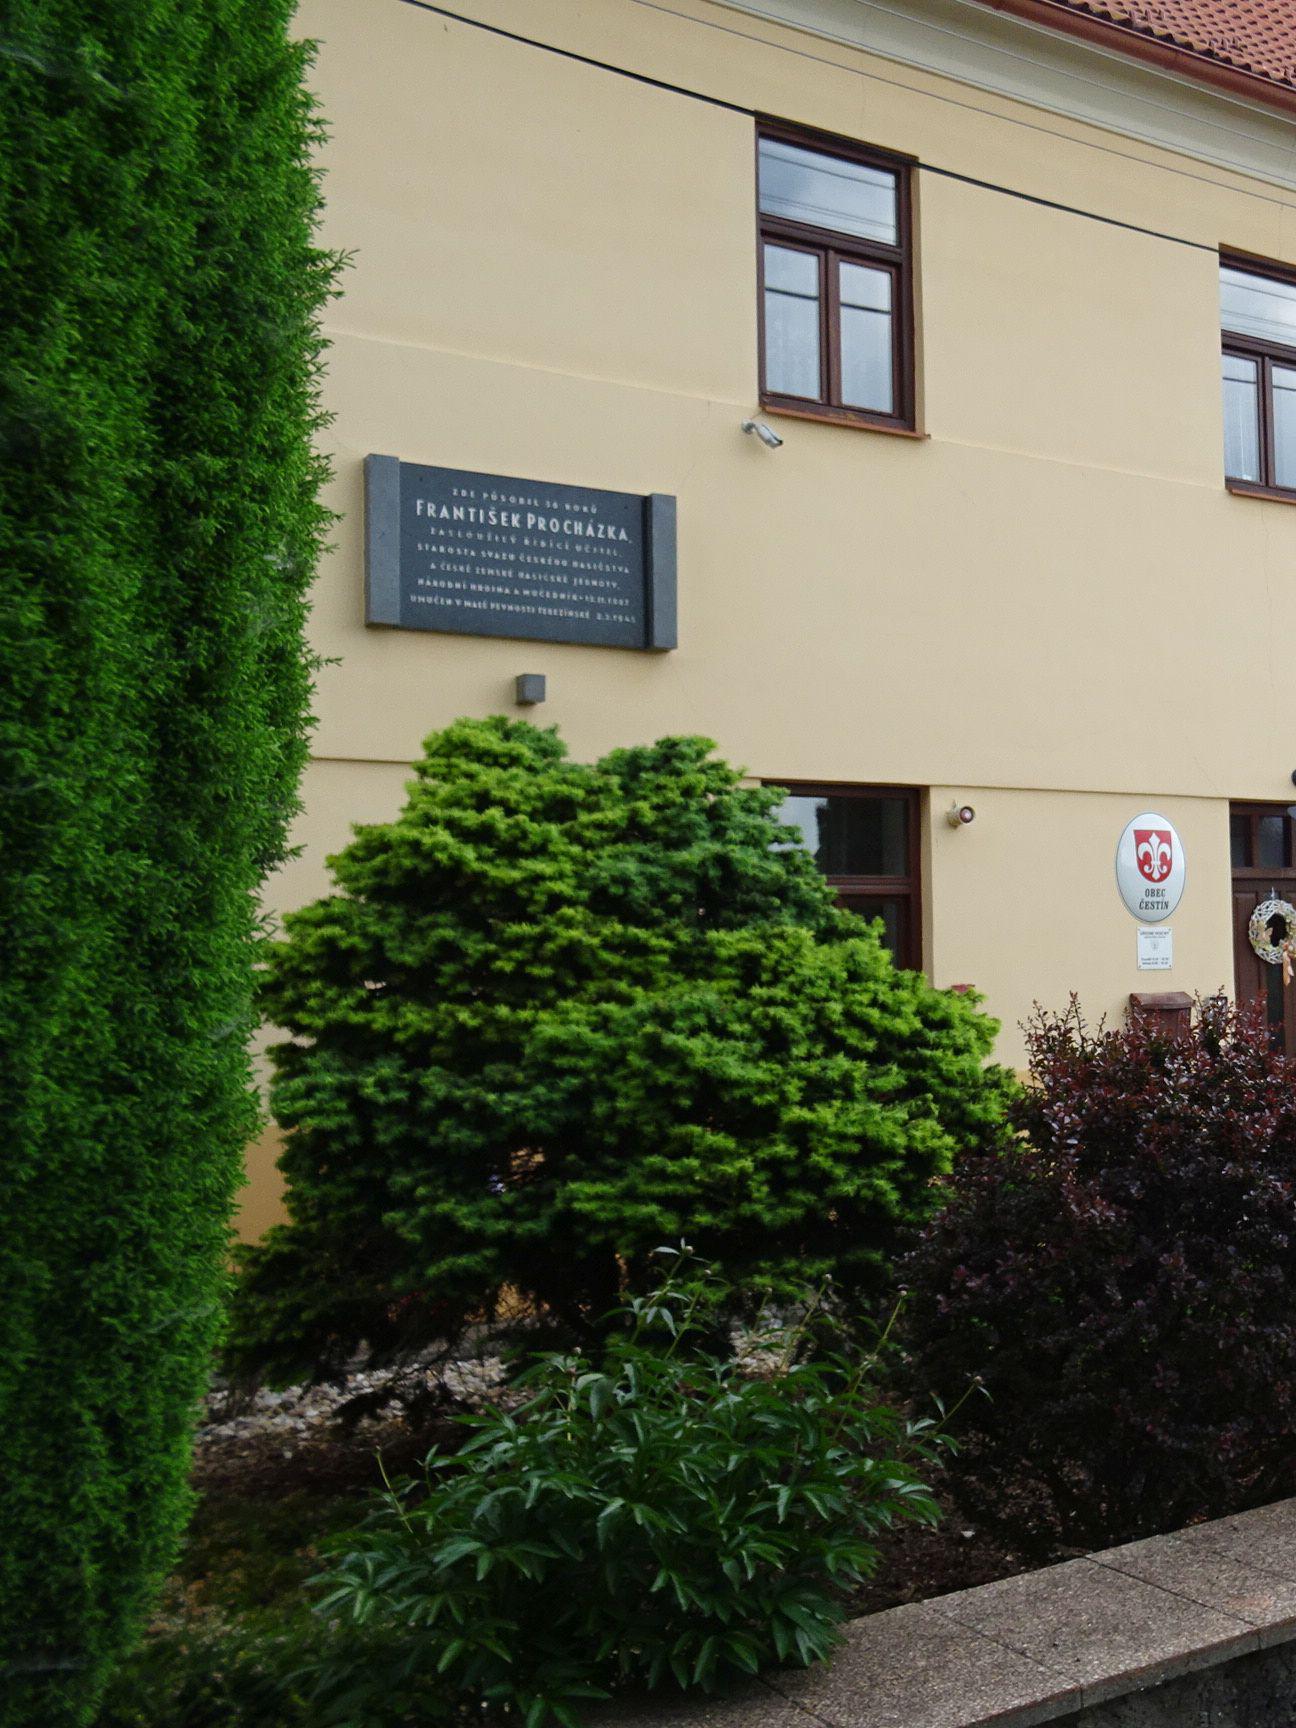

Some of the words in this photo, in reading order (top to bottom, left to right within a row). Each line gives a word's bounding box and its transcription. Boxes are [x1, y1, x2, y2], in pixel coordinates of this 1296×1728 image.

[453, 488, 475, 498] ZDE
[416, 499, 521, 529] FRANTIŠEK
[417, 543, 476, 557] STAROSTA
[481, 550, 515, 560] SVAZU
[519, 554, 568, 567] ČESKÉHO
[430, 562, 437, 570] A
[440, 562, 471, 573] ČESKÉ
[417, 577, 467, 590] NÁRODNÍ
[1145, 888, 1166, 898] OBEC
[1139, 898, 1169, 910] ČESTÍN
